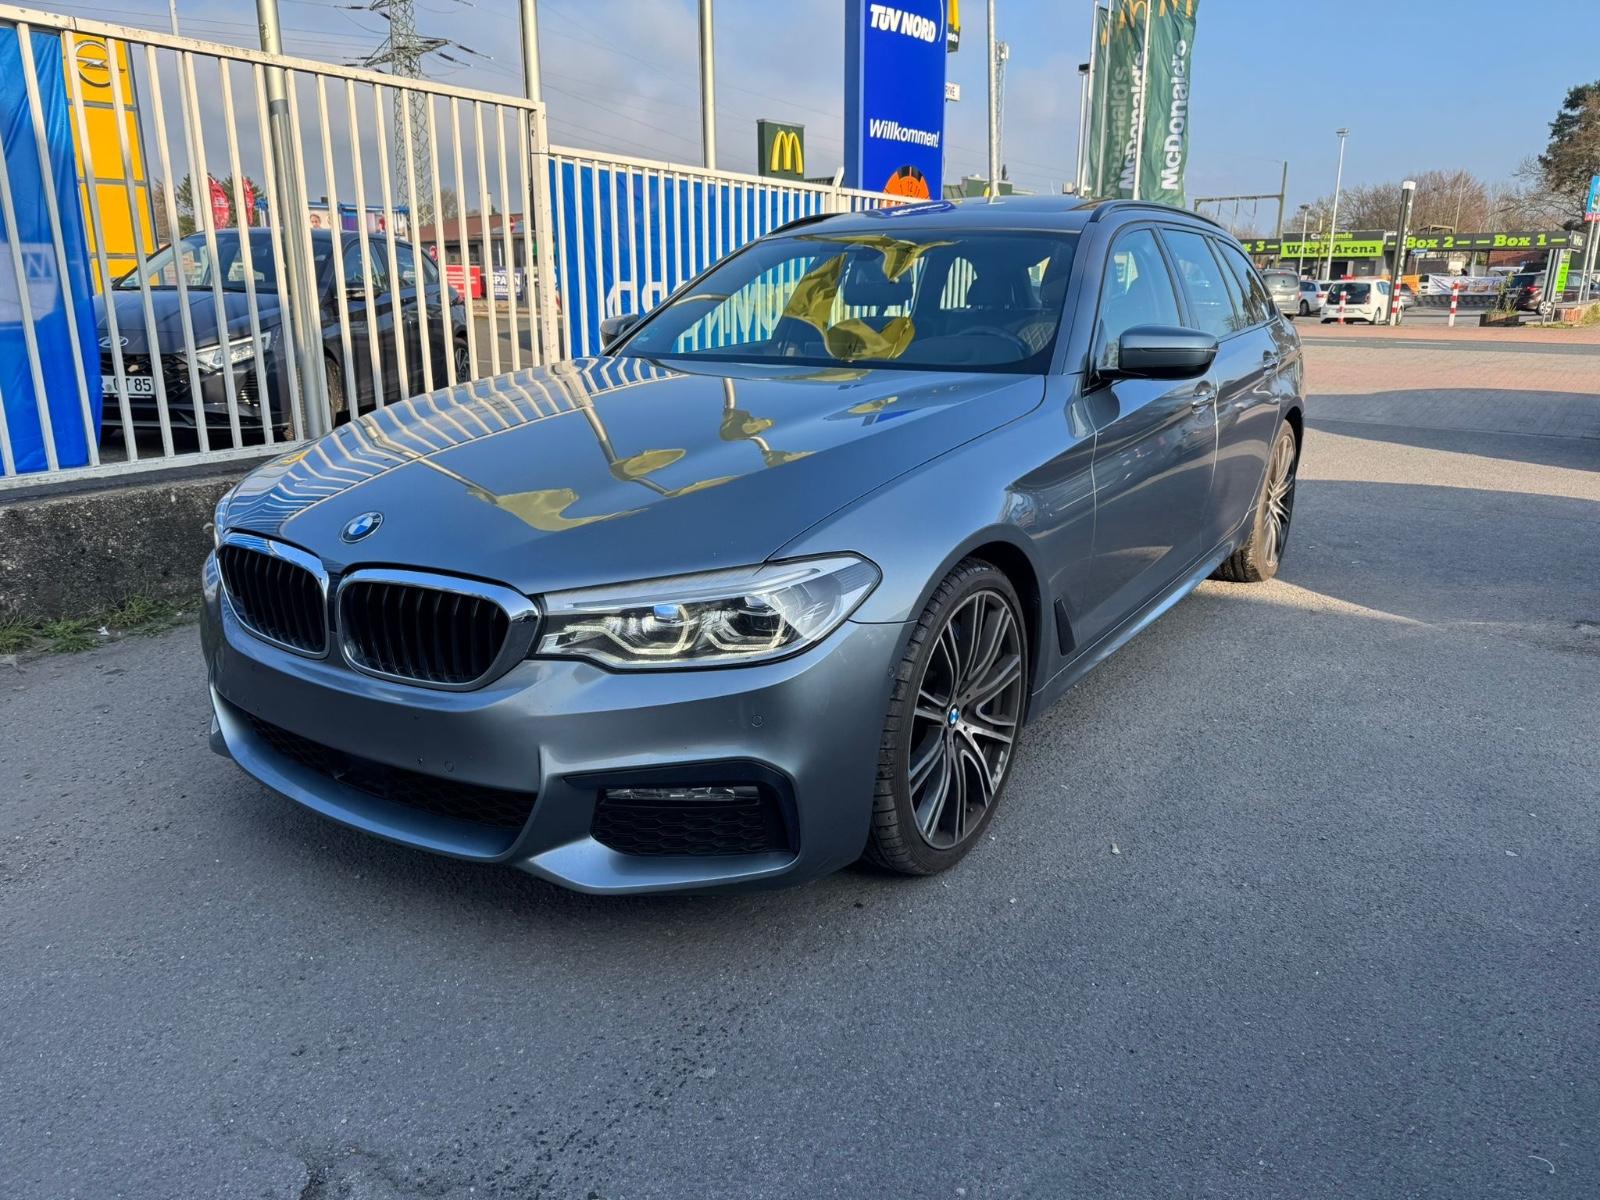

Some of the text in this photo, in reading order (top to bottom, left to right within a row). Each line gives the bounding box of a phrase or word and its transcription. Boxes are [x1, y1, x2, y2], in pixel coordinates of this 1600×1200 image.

[870, 3, 937, 43] TÜV NORD
[1161, 39, 1188, 190] McDonald's
[869, 118, 940, 148] Willkommen!
[1255, 241, 1265, 252] 3
[1407, 236, 1454, 248] Box 2
[1494, 234, 1547, 247] Box 1
[134, 378, 152, 392] 85
